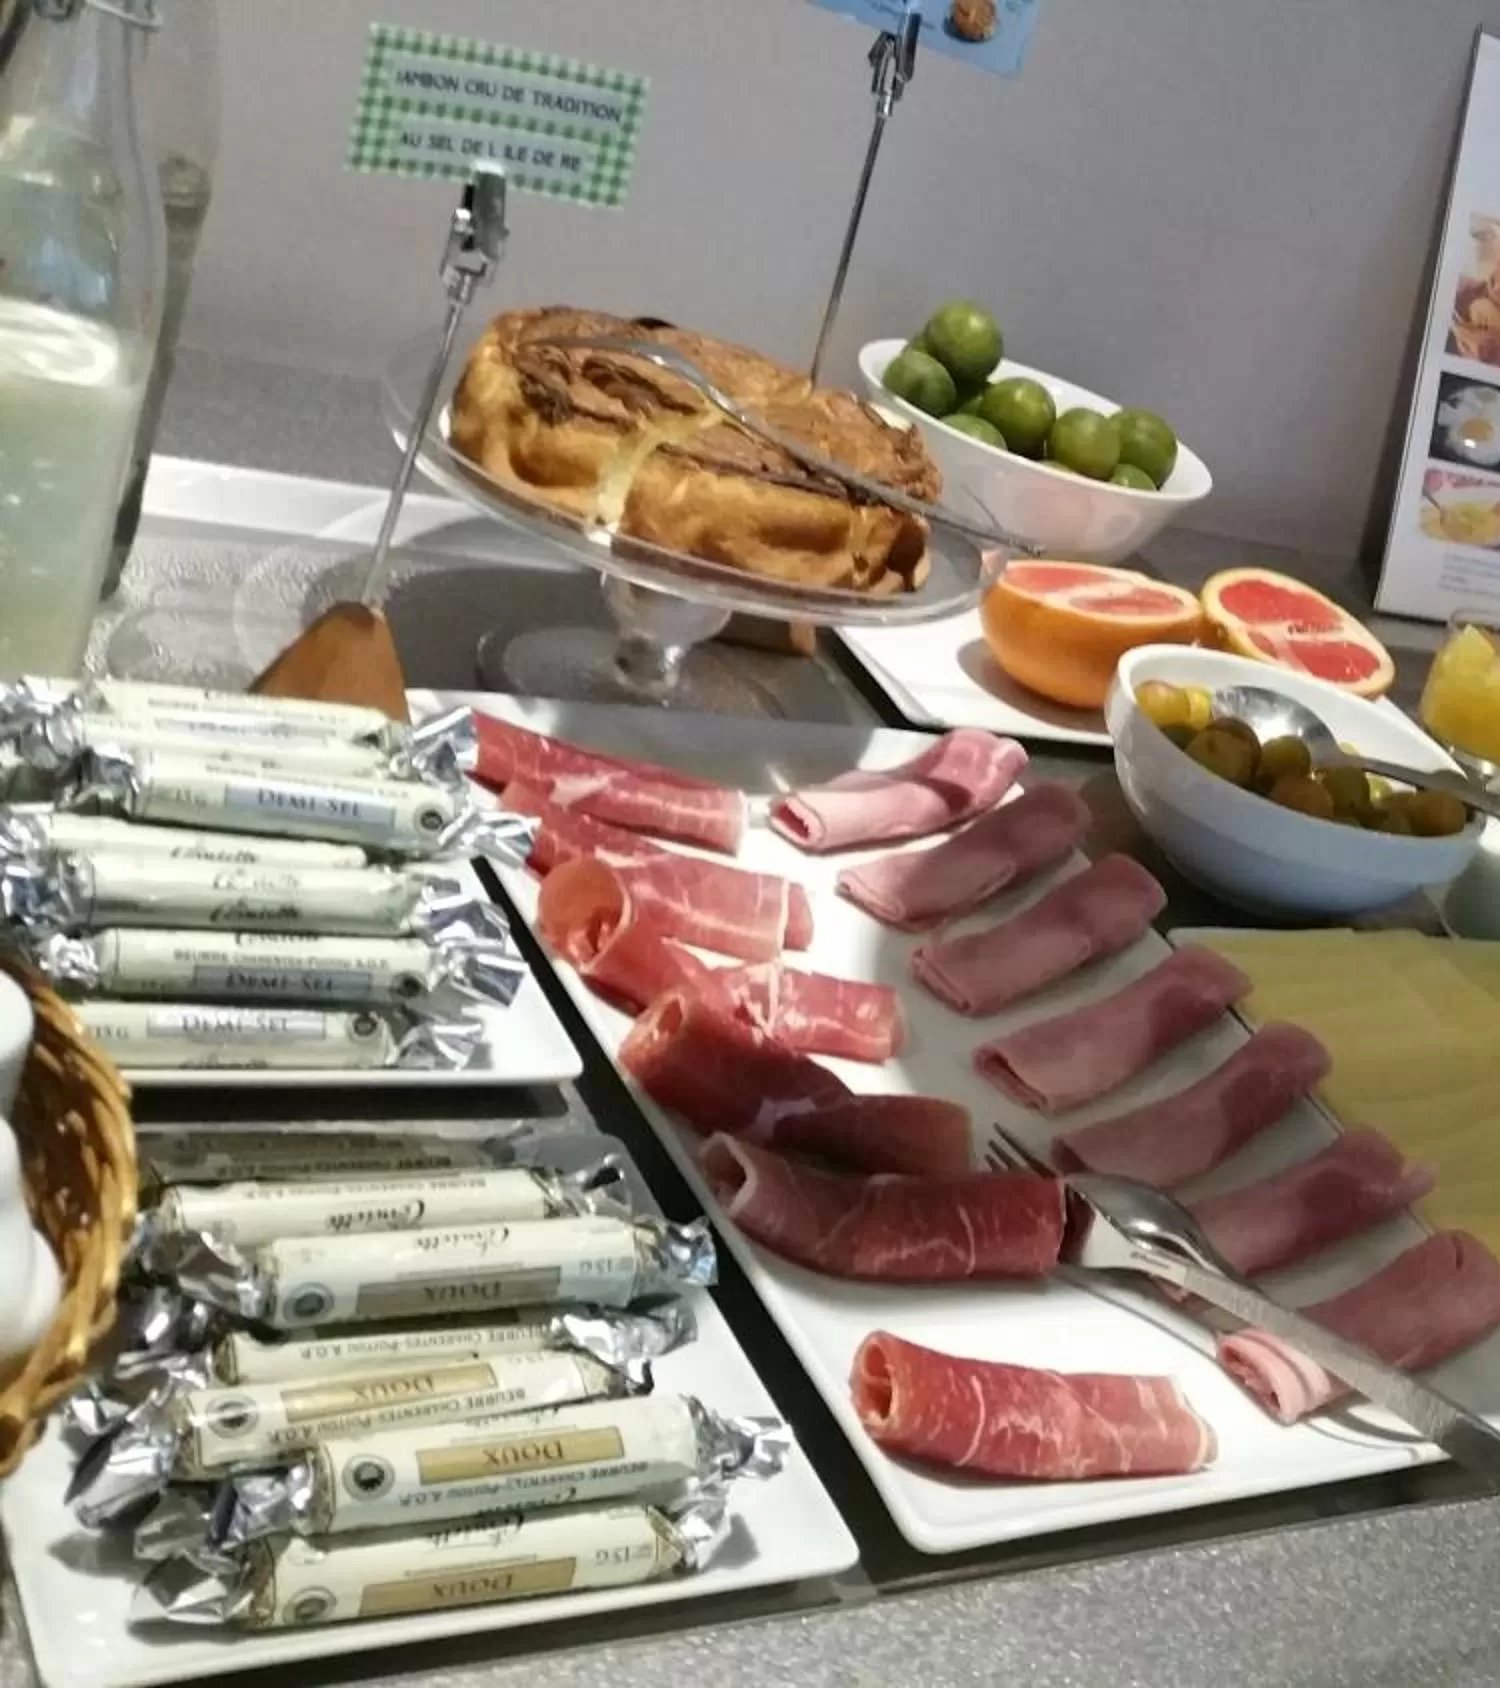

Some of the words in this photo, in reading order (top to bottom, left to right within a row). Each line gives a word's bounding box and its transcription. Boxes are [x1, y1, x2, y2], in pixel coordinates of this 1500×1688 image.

[502, 86, 526, 104] DE
[532, 90, 622, 122] TRADITION
[401, 132, 422, 147] AU
[461, 138, 484, 155] DE
[532, 149, 556, 167] DE
[423, 1279, 502, 1301] DOUX
[352, 1375, 434, 1401] DOUX
[482, 1440, 565, 1467] DOUX
[432, 1573, 514, 1598] DOUX
